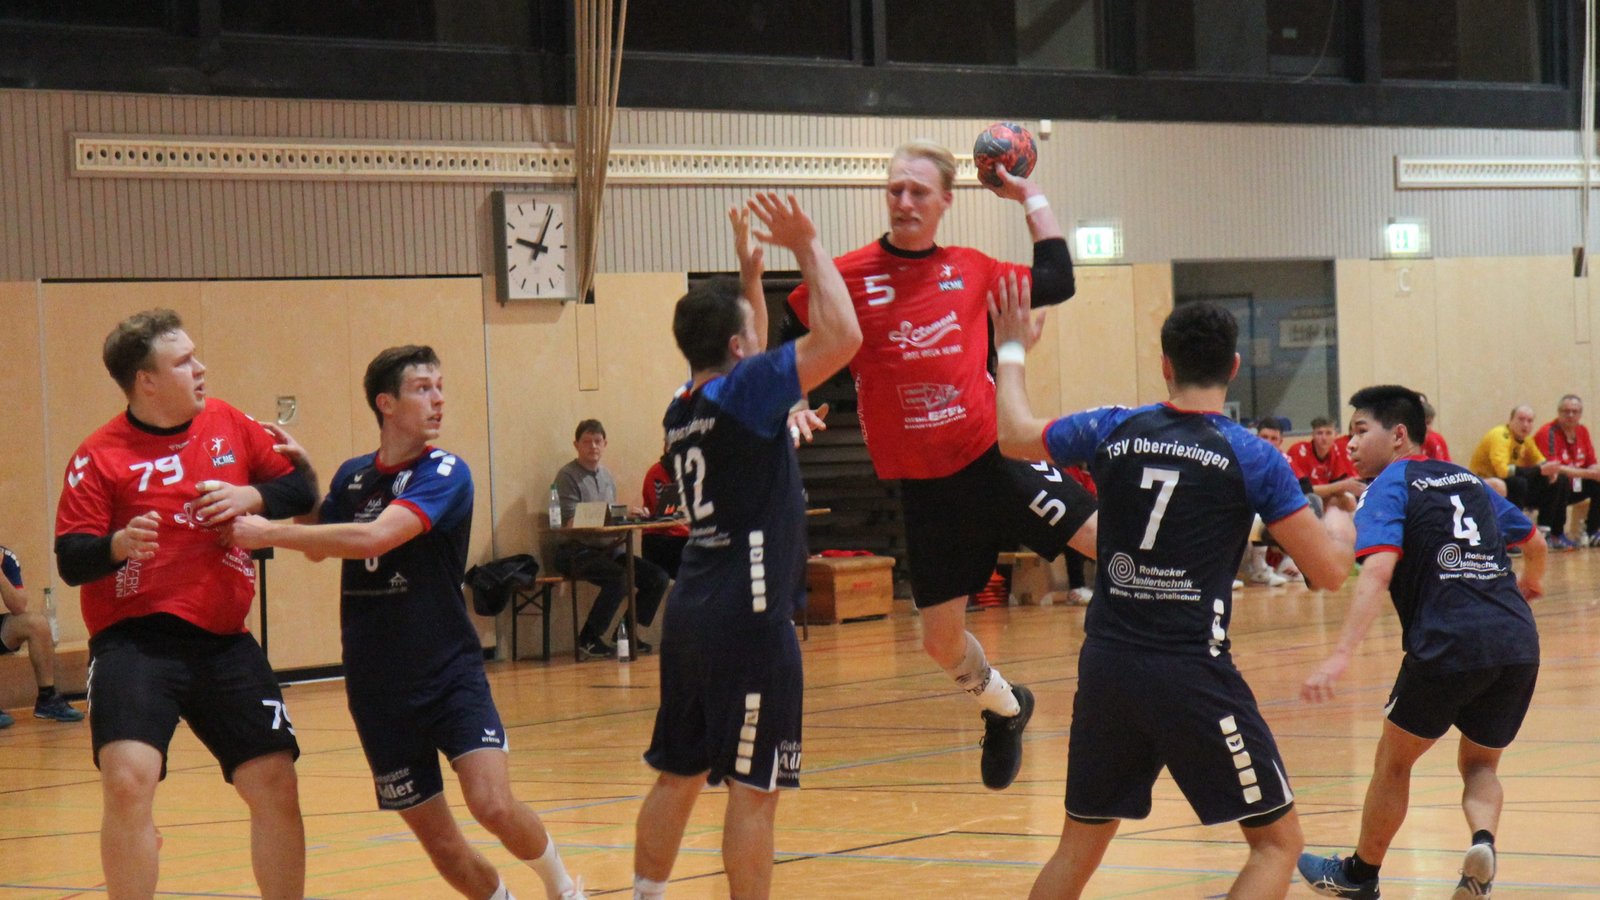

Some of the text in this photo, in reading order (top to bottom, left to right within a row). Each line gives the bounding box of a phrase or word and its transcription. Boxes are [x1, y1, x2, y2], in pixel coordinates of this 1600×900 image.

[864, 274, 896, 306] 5
[129, 454, 184, 492] 79
[1107, 437, 1230, 471] TSV Oberriexingen
[674, 447, 714, 523] 12
[1029, 489, 1067, 527] 5
[1140, 466, 1180, 550] 7
[1450, 494, 1481, 546] 4
[1139, 565, 1187, 577] Rothacker
[779, 752, 802, 770] Adl
